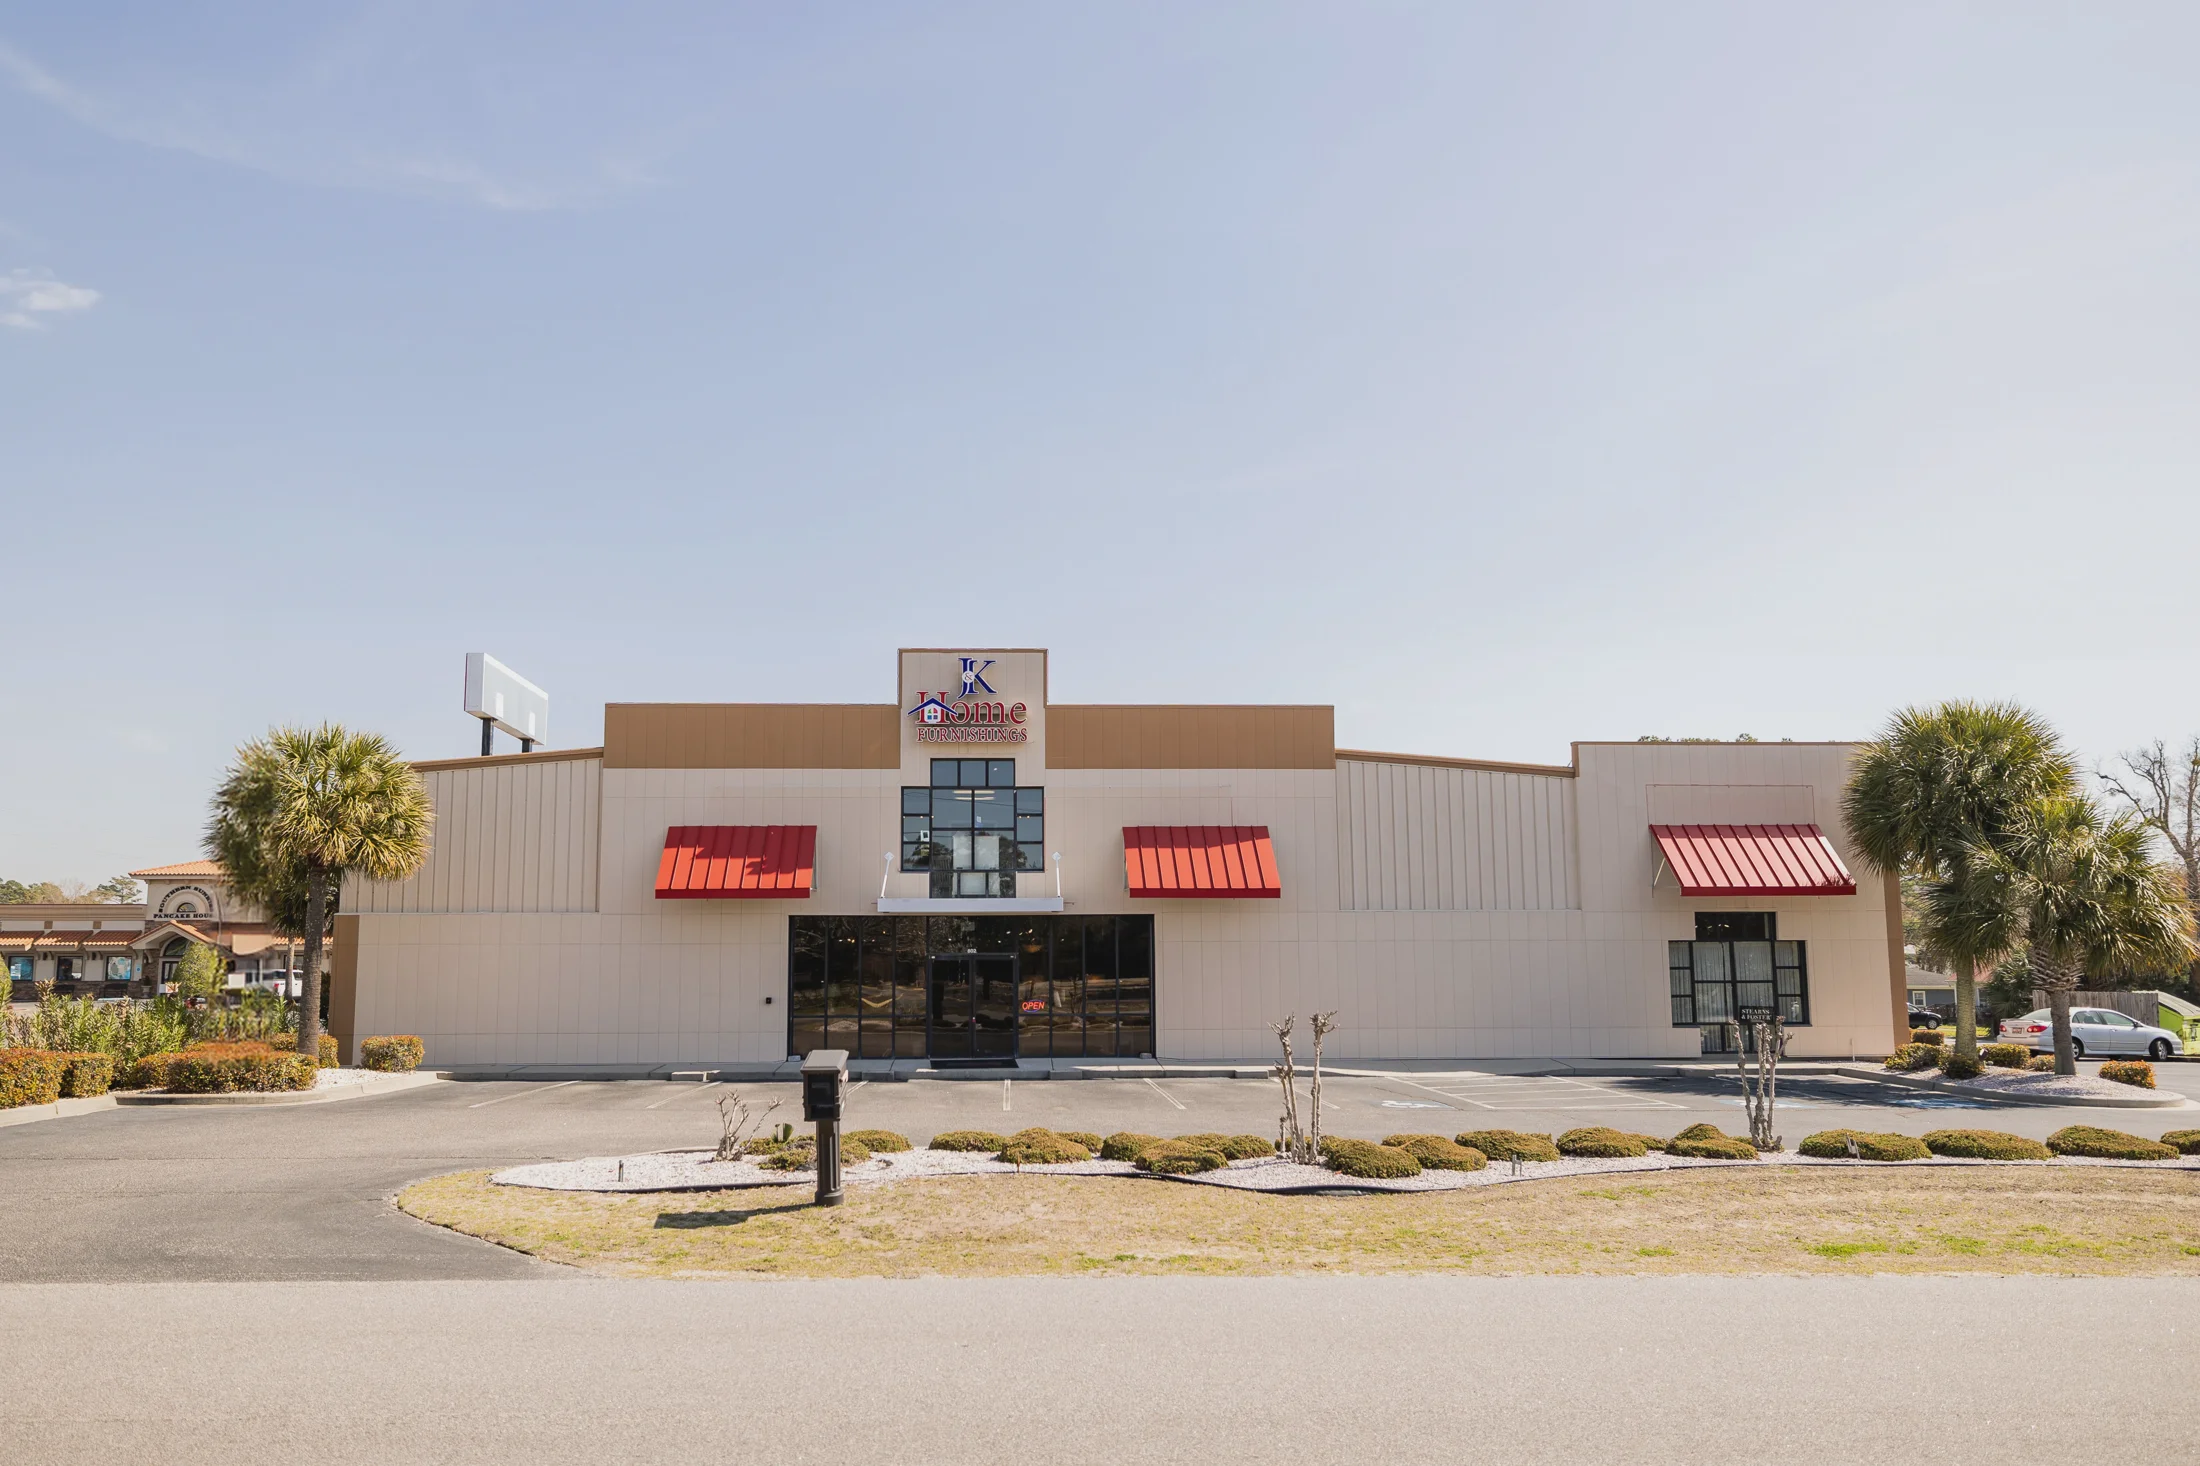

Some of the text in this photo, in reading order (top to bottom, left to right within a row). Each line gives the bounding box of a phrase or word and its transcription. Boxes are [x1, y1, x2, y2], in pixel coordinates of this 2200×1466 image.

[916, 691, 1027, 725] Home
[917, 727, 1028, 743] FURNISHINGS
[159, 886, 192, 913] SOUTHERN
[1021, 1001, 1045, 1011] OPEN
